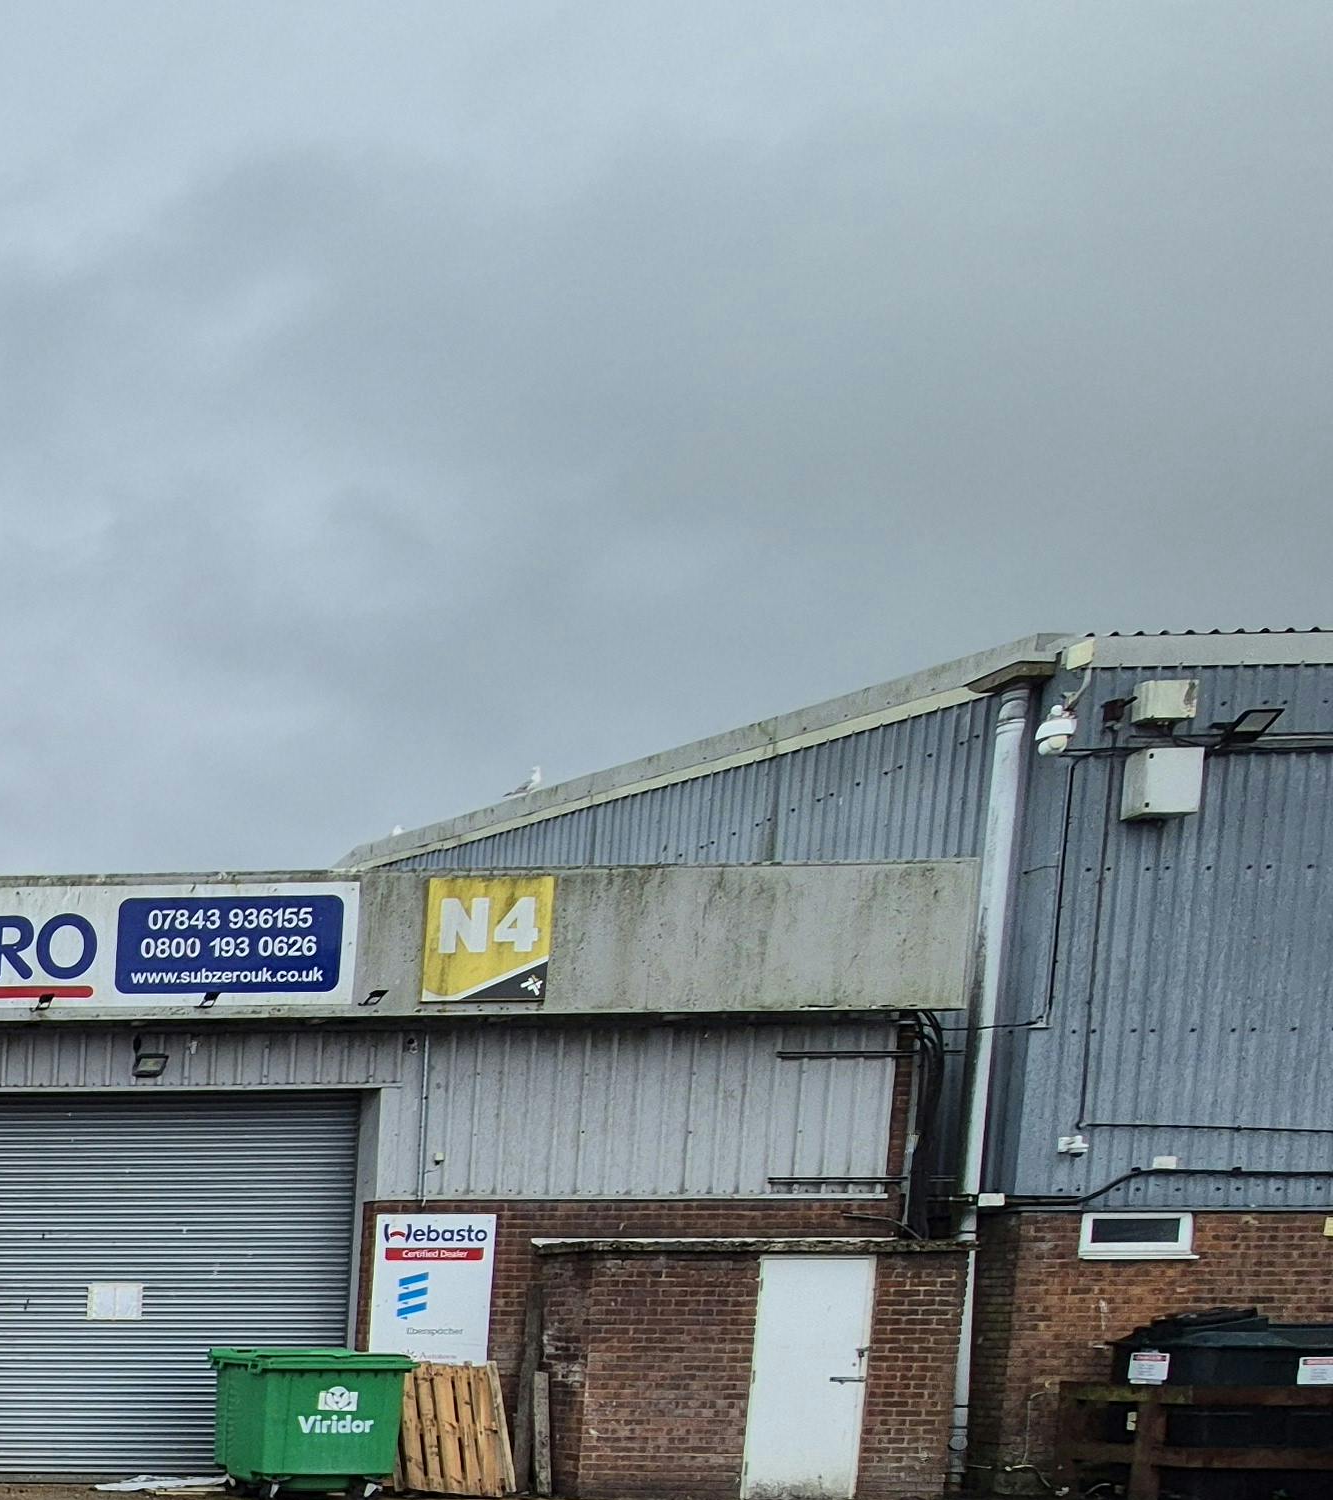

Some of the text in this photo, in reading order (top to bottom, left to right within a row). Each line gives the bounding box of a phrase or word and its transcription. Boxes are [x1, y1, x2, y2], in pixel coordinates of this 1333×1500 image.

[147, 906, 313, 931] 07843 936155
[438, 896, 539, 954] N4
[140, 934, 318, 959] 0800 193 0626
[130, 966, 324, 985] www.subzerouk.co.uk
[383, 1223, 488, 1244] Webasto
[401, 1249, 469, 1258] Certified Dealer
[297, 1414, 375, 1434] Viridor
